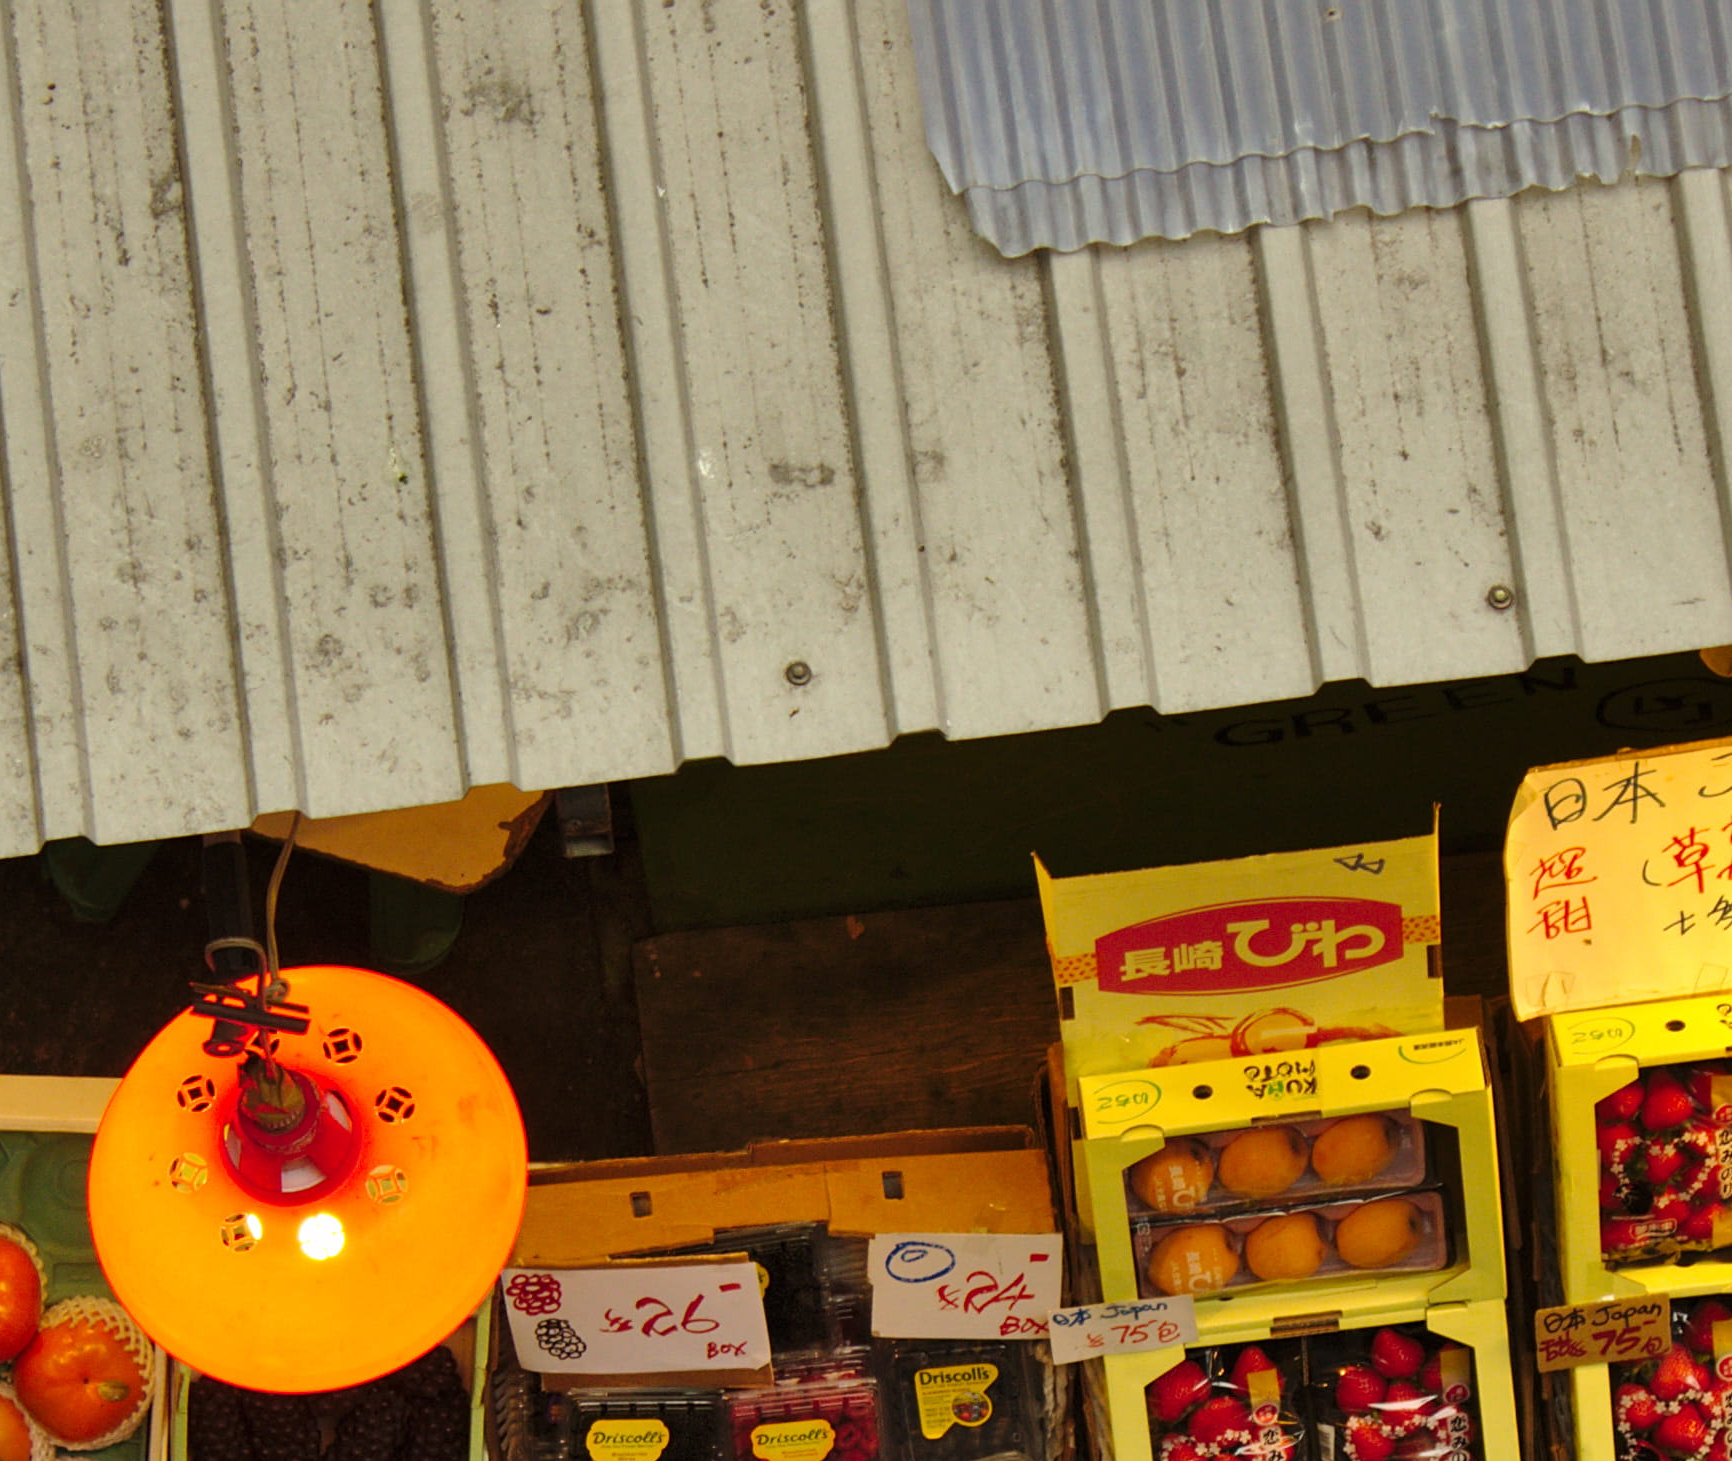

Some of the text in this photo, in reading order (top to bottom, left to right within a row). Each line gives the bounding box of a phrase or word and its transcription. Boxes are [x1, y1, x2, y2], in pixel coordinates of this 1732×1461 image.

[1544, 760, 1666, 831] 日本
[1099, 1302, 1169, 1321] Japan
[1543, 1301, 1663, 1334] 日本 Japan
[999, 1316, 1051, 1336] BOX
[706, 1340, 748, 1359] BOX
[920, 1367, 991, 1386] Driscoll's
[593, 1430, 664, 1446] Driscoll's
[756, 1428, 830, 1447] Driscoll's
